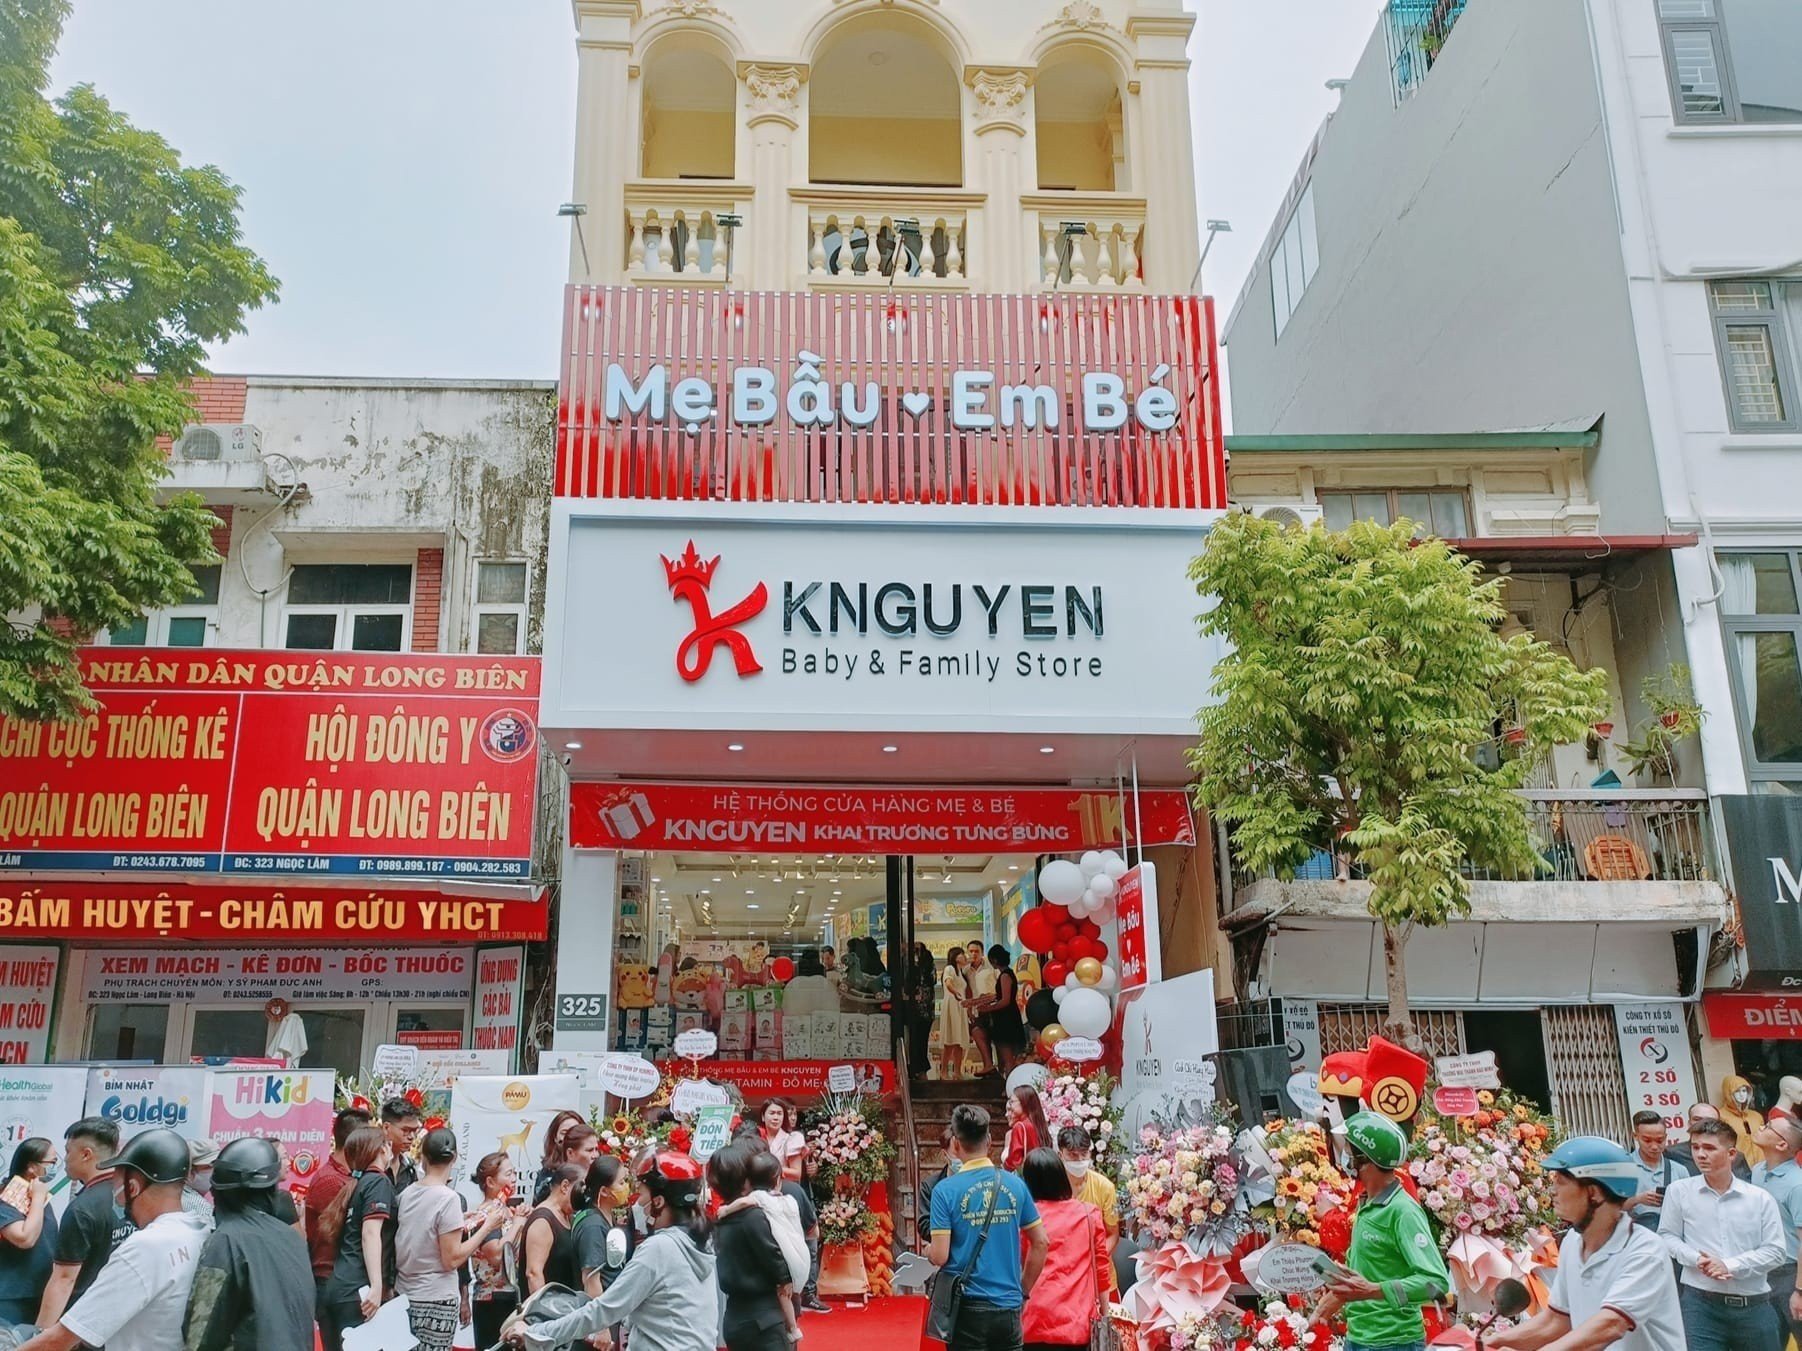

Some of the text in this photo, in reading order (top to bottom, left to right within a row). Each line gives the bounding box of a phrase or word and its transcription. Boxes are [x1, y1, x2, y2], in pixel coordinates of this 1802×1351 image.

[604, 350, 1179, 436] Mẹ Bầu Em Bé
[783, 580, 1105, 639] KNGUYEN
[87, 656, 528, 691] NHÂN DÂN QUẬN LONG BIÊN
[782, 648, 1102, 682] Baby & Family Store
[106, 699, 189, 760] THỐNG
[193, 707, 228, 759] KÊ
[305, 704, 358, 772] HỘI
[365, 705, 449, 764] ĐÔNG
[459, 717, 478, 764] Y
[0, 783, 208, 847] QUẬN LONG BIÊN
[256, 778, 511, 848] QUẬN LONG BIÊN
[714, 790, 1016, 816] HỆ THỐNG CỬA HÀNG MẸ & BÉ
[664, 819, 806, 842] KNGUYEN
[814, 825, 863, 840] KHAI
[865, 824, 949, 841] TRƯƠNG
[953, 824, 1008, 841] TƯNG
[130, 856, 206, 868] 0243.678.7095
[234, 857, 330, 871] ĐC: 323 NGỌC LÂM
[376, 860, 444, 872] 0989.899.187
[453, 861, 521, 873] 0904.282.583
[83, 893, 194, 935] HUYỆT
[219, 893, 323, 929] CHÂM
[335, 893, 406, 930] CỨU
[418, 902, 505, 931] YHCT
[10, 956, 55, 993] HUYỆT
[100, 957, 149, 974] XEM
[155, 957, 220, 977] MẠCH
[241, 953, 269, 973] KÊ
[276, 955, 322, 973] ĐƠN
[343, 951, 388, 973] BỐC
[395, 951, 464, 973] THUỐC
[17, 998, 46, 1029] CỨU
[562, 997, 601, 1016] 325
[1626, 1010, 1643, 1020] CÔNG
[1644, 1011, 1651, 1020] TY
[735, 1078, 772, 1088] TAMIN
[782, 1075, 800, 1088] ĐỒ
[1640, 1066, 1677, 1083] 2 SỐ
[236, 1075, 309, 1104] Hikid
[1643, 1089, 1681, 1105] 3 SỐ
[101, 1095, 188, 1127] Goldgi
[1663, 1112, 1684, 1129] SỐ
[300, 1128, 325, 1144] DIỆN
[1353, 1128, 1376, 1150] Grab
